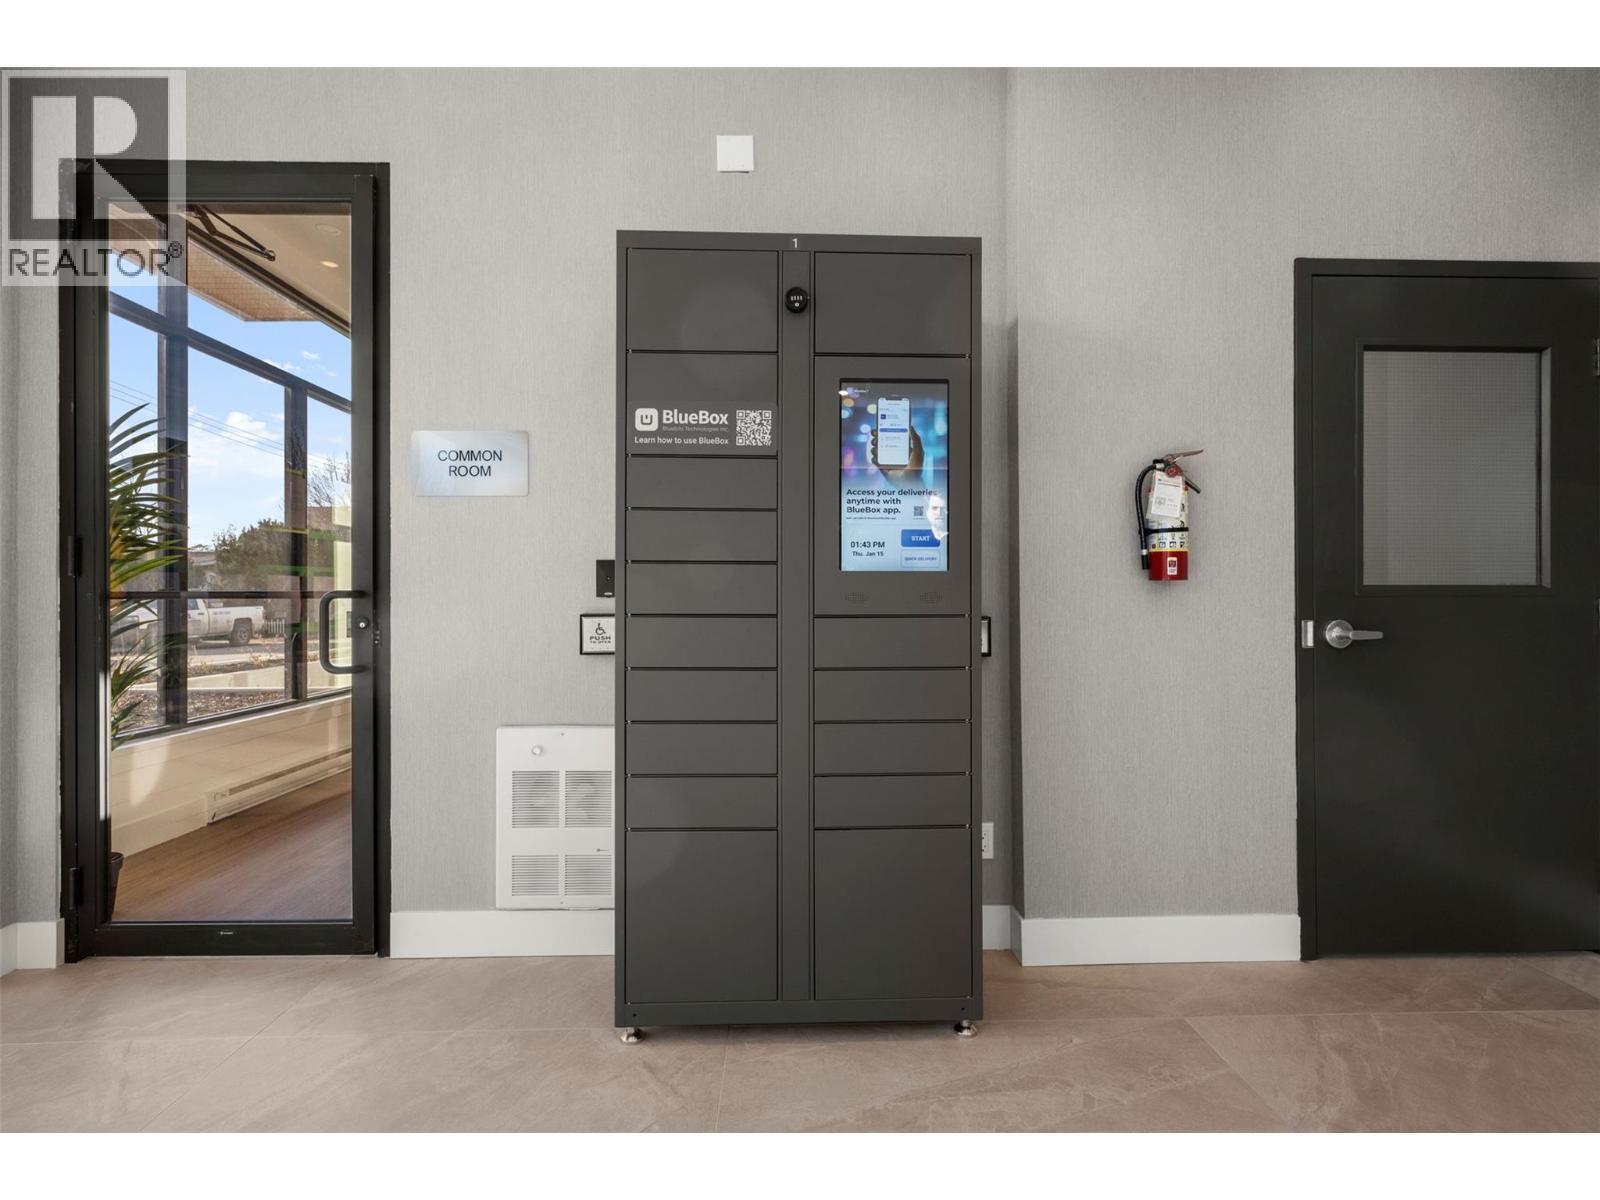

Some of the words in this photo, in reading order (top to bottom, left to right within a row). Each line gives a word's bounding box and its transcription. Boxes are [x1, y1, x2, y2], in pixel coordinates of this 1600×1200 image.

[792, 238, 798, 249] 1
[662, 409, 728, 424] BlueBox
[634, 436, 656, 444] Learn
[657, 436, 672, 444] how
[698, 436, 729, 444] BlueBox
[437, 449, 503, 462] COMMON
[448, 465, 492, 477] ROOM
[846, 488, 875, 496] Access
[877, 489, 896, 497] your
[846, 497, 880, 506] anytime
[882, 497, 902, 505] with
[846, 506, 881, 514] BlueBox
